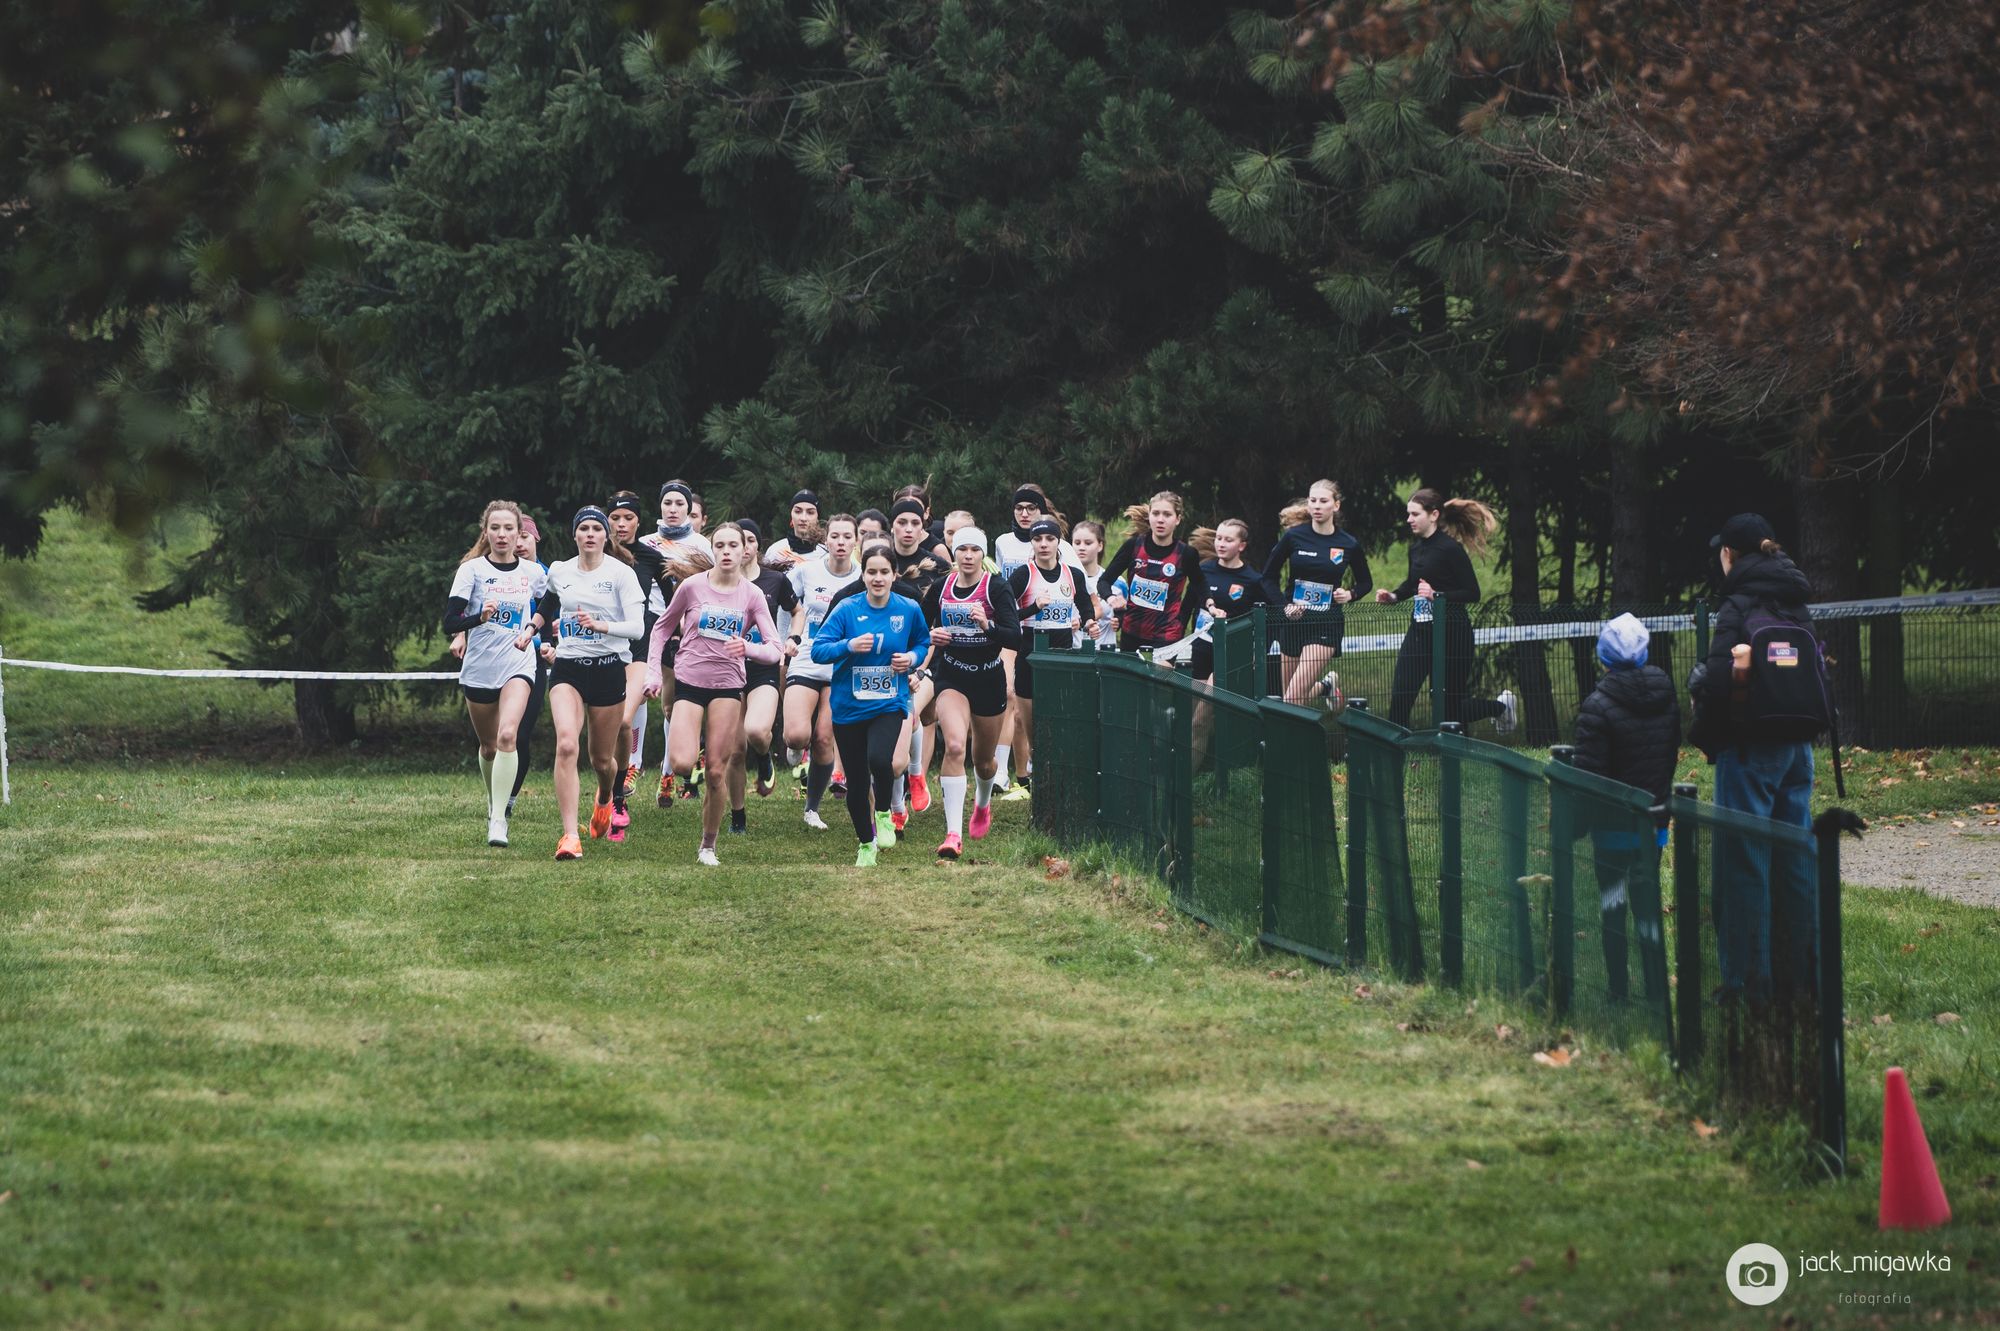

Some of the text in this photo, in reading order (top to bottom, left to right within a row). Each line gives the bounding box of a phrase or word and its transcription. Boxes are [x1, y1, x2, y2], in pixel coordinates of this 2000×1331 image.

[487, 586, 528, 594] POLSKA
[1134, 586, 1161, 602] 247
[1303, 590, 1321, 603] 53
[490, 610, 512, 624] 49
[946, 613, 975, 627] 125
[1042, 607, 1069, 621] 383
[706, 616, 738, 633] 324
[598, 654, 620, 666] NIK
[953, 659, 979, 672] PRO
[861, 676, 892, 691] 356
